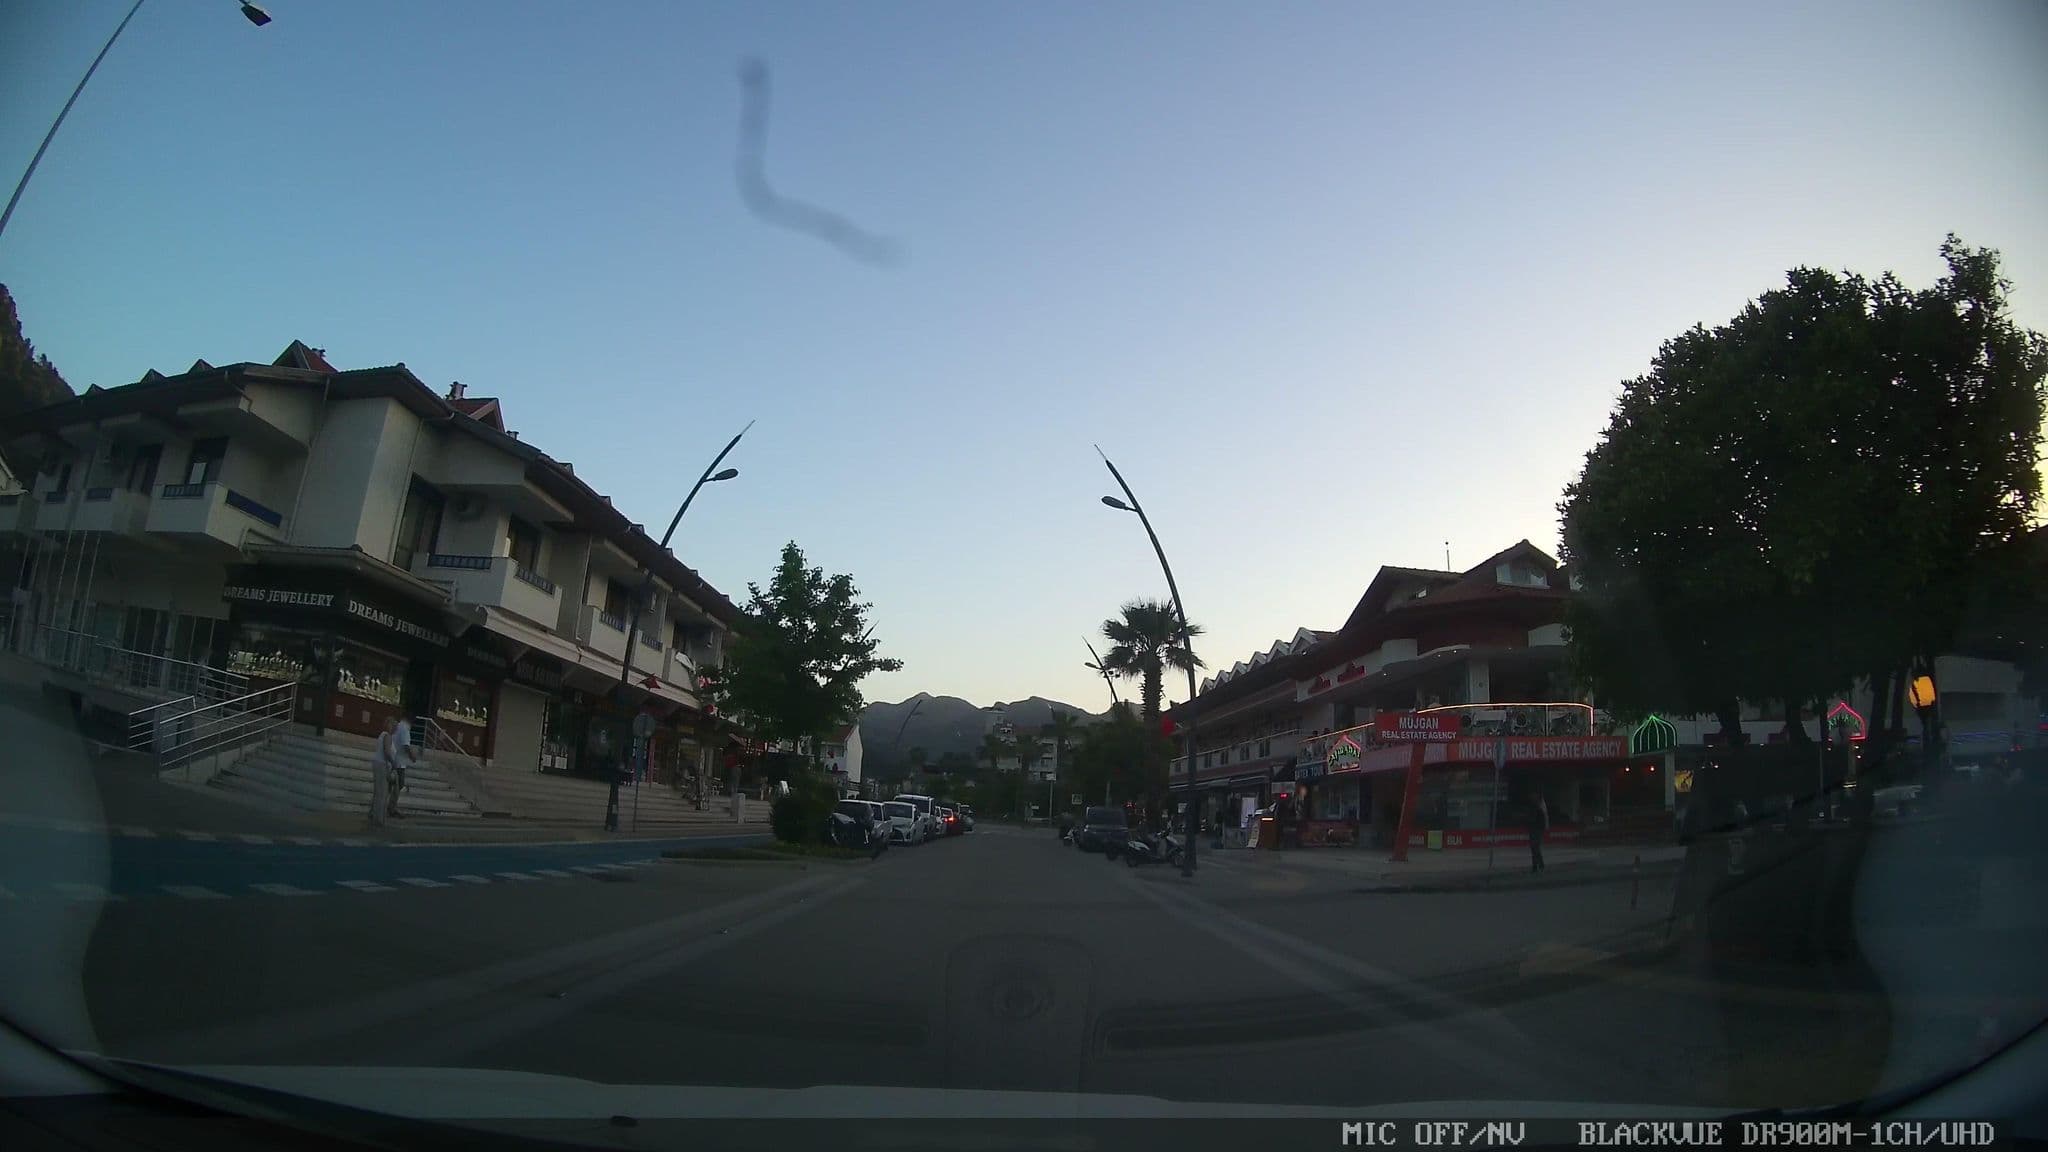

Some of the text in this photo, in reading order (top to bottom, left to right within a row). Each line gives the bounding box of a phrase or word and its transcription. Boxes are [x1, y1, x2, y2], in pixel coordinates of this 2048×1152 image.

[266, 590, 334, 607] JEWELLERY
[349, 599, 453, 649] DREAMS JEWELLER
[1382, 730, 1457, 740] REAL ESTATE AGENCY
[1511, 741, 1539, 760] REAL
[1542, 741, 1581, 759] ESTATE
[1582, 741, 1622, 759] AGENCY
